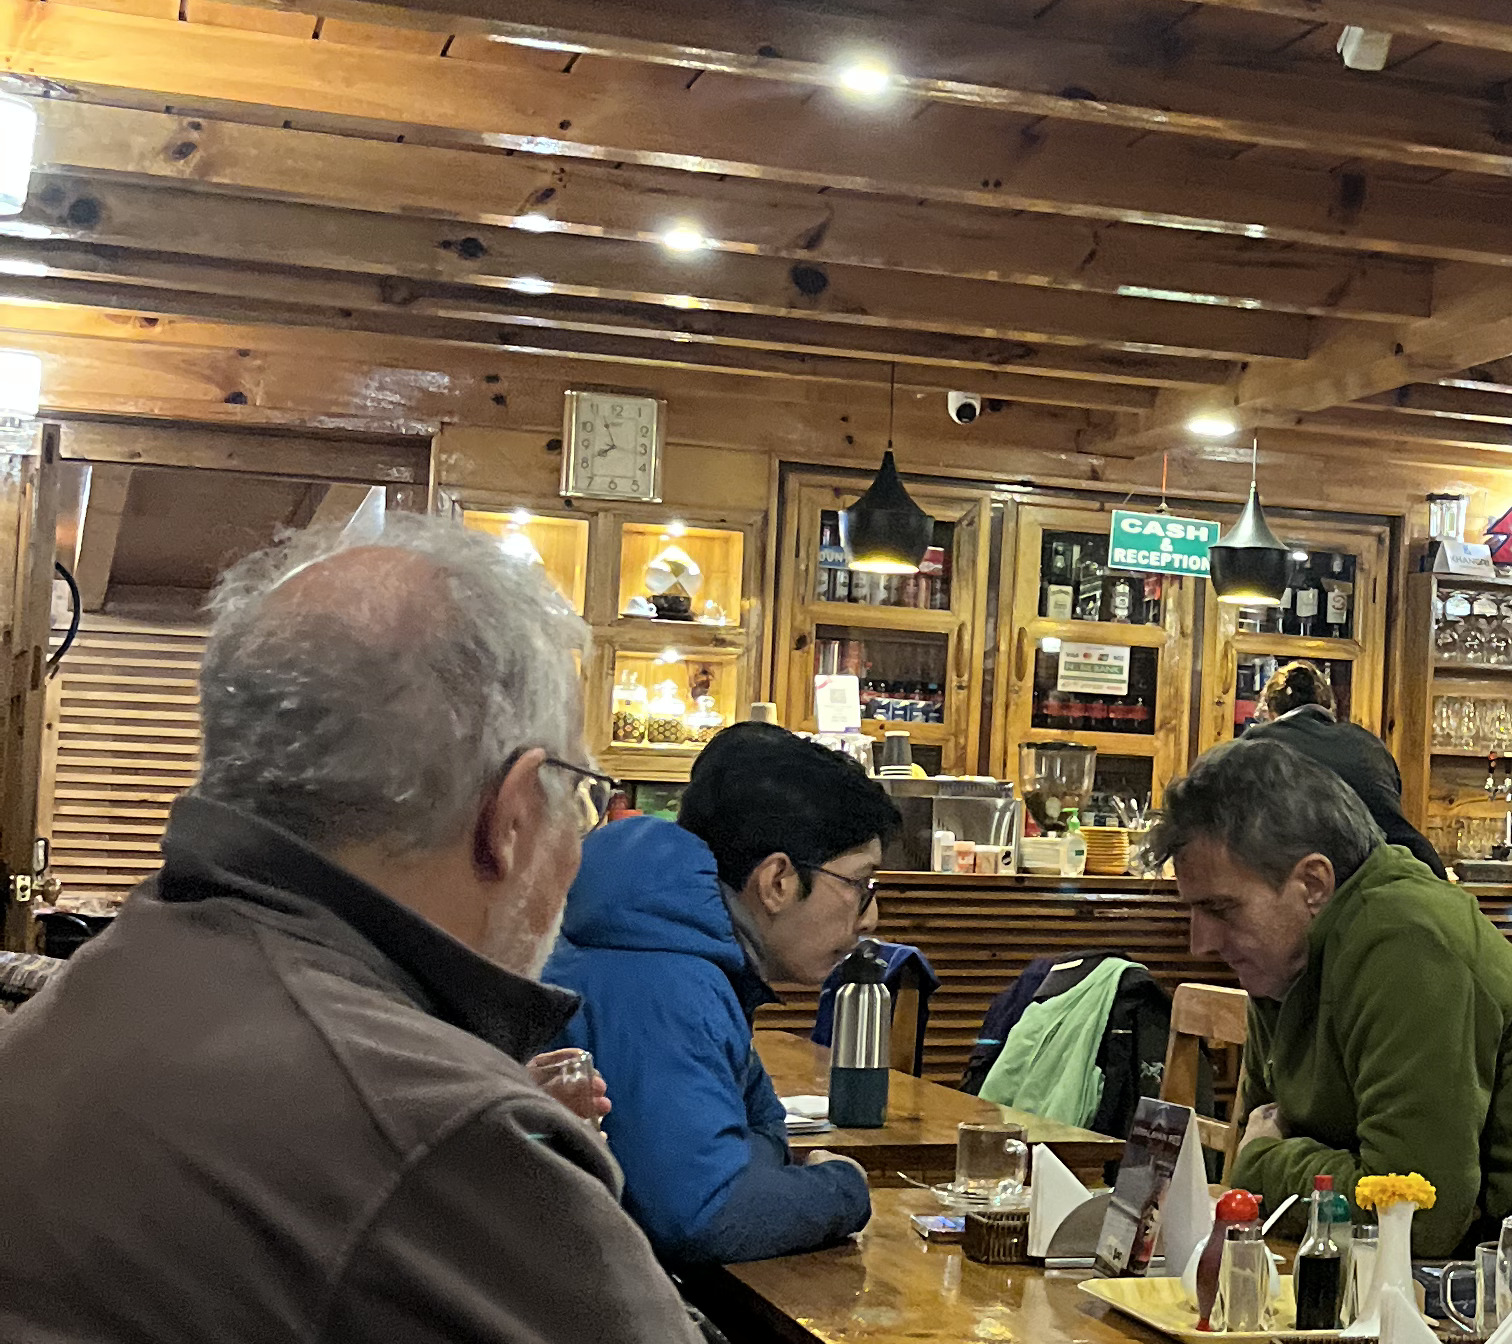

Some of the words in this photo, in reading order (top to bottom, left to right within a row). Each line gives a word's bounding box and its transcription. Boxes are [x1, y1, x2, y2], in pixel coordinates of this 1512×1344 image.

[612, 404, 624, 417] 12
[582, 420, 594, 433] 10
[640, 425, 649, 438] 2
[581, 439, 590, 451] 9
[640, 443, 648, 456] 3
[581, 457, 590, 469] 8
[638, 463, 647, 473] 4
[585, 476, 594, 489] 7
[608, 479, 618, 490] 6
[630, 479, 640, 493] 5
[1120, 517, 1209, 543] CASH
[1160, 537, 1173, 552] &
[1113, 547, 1210, 571] RECEPTION
